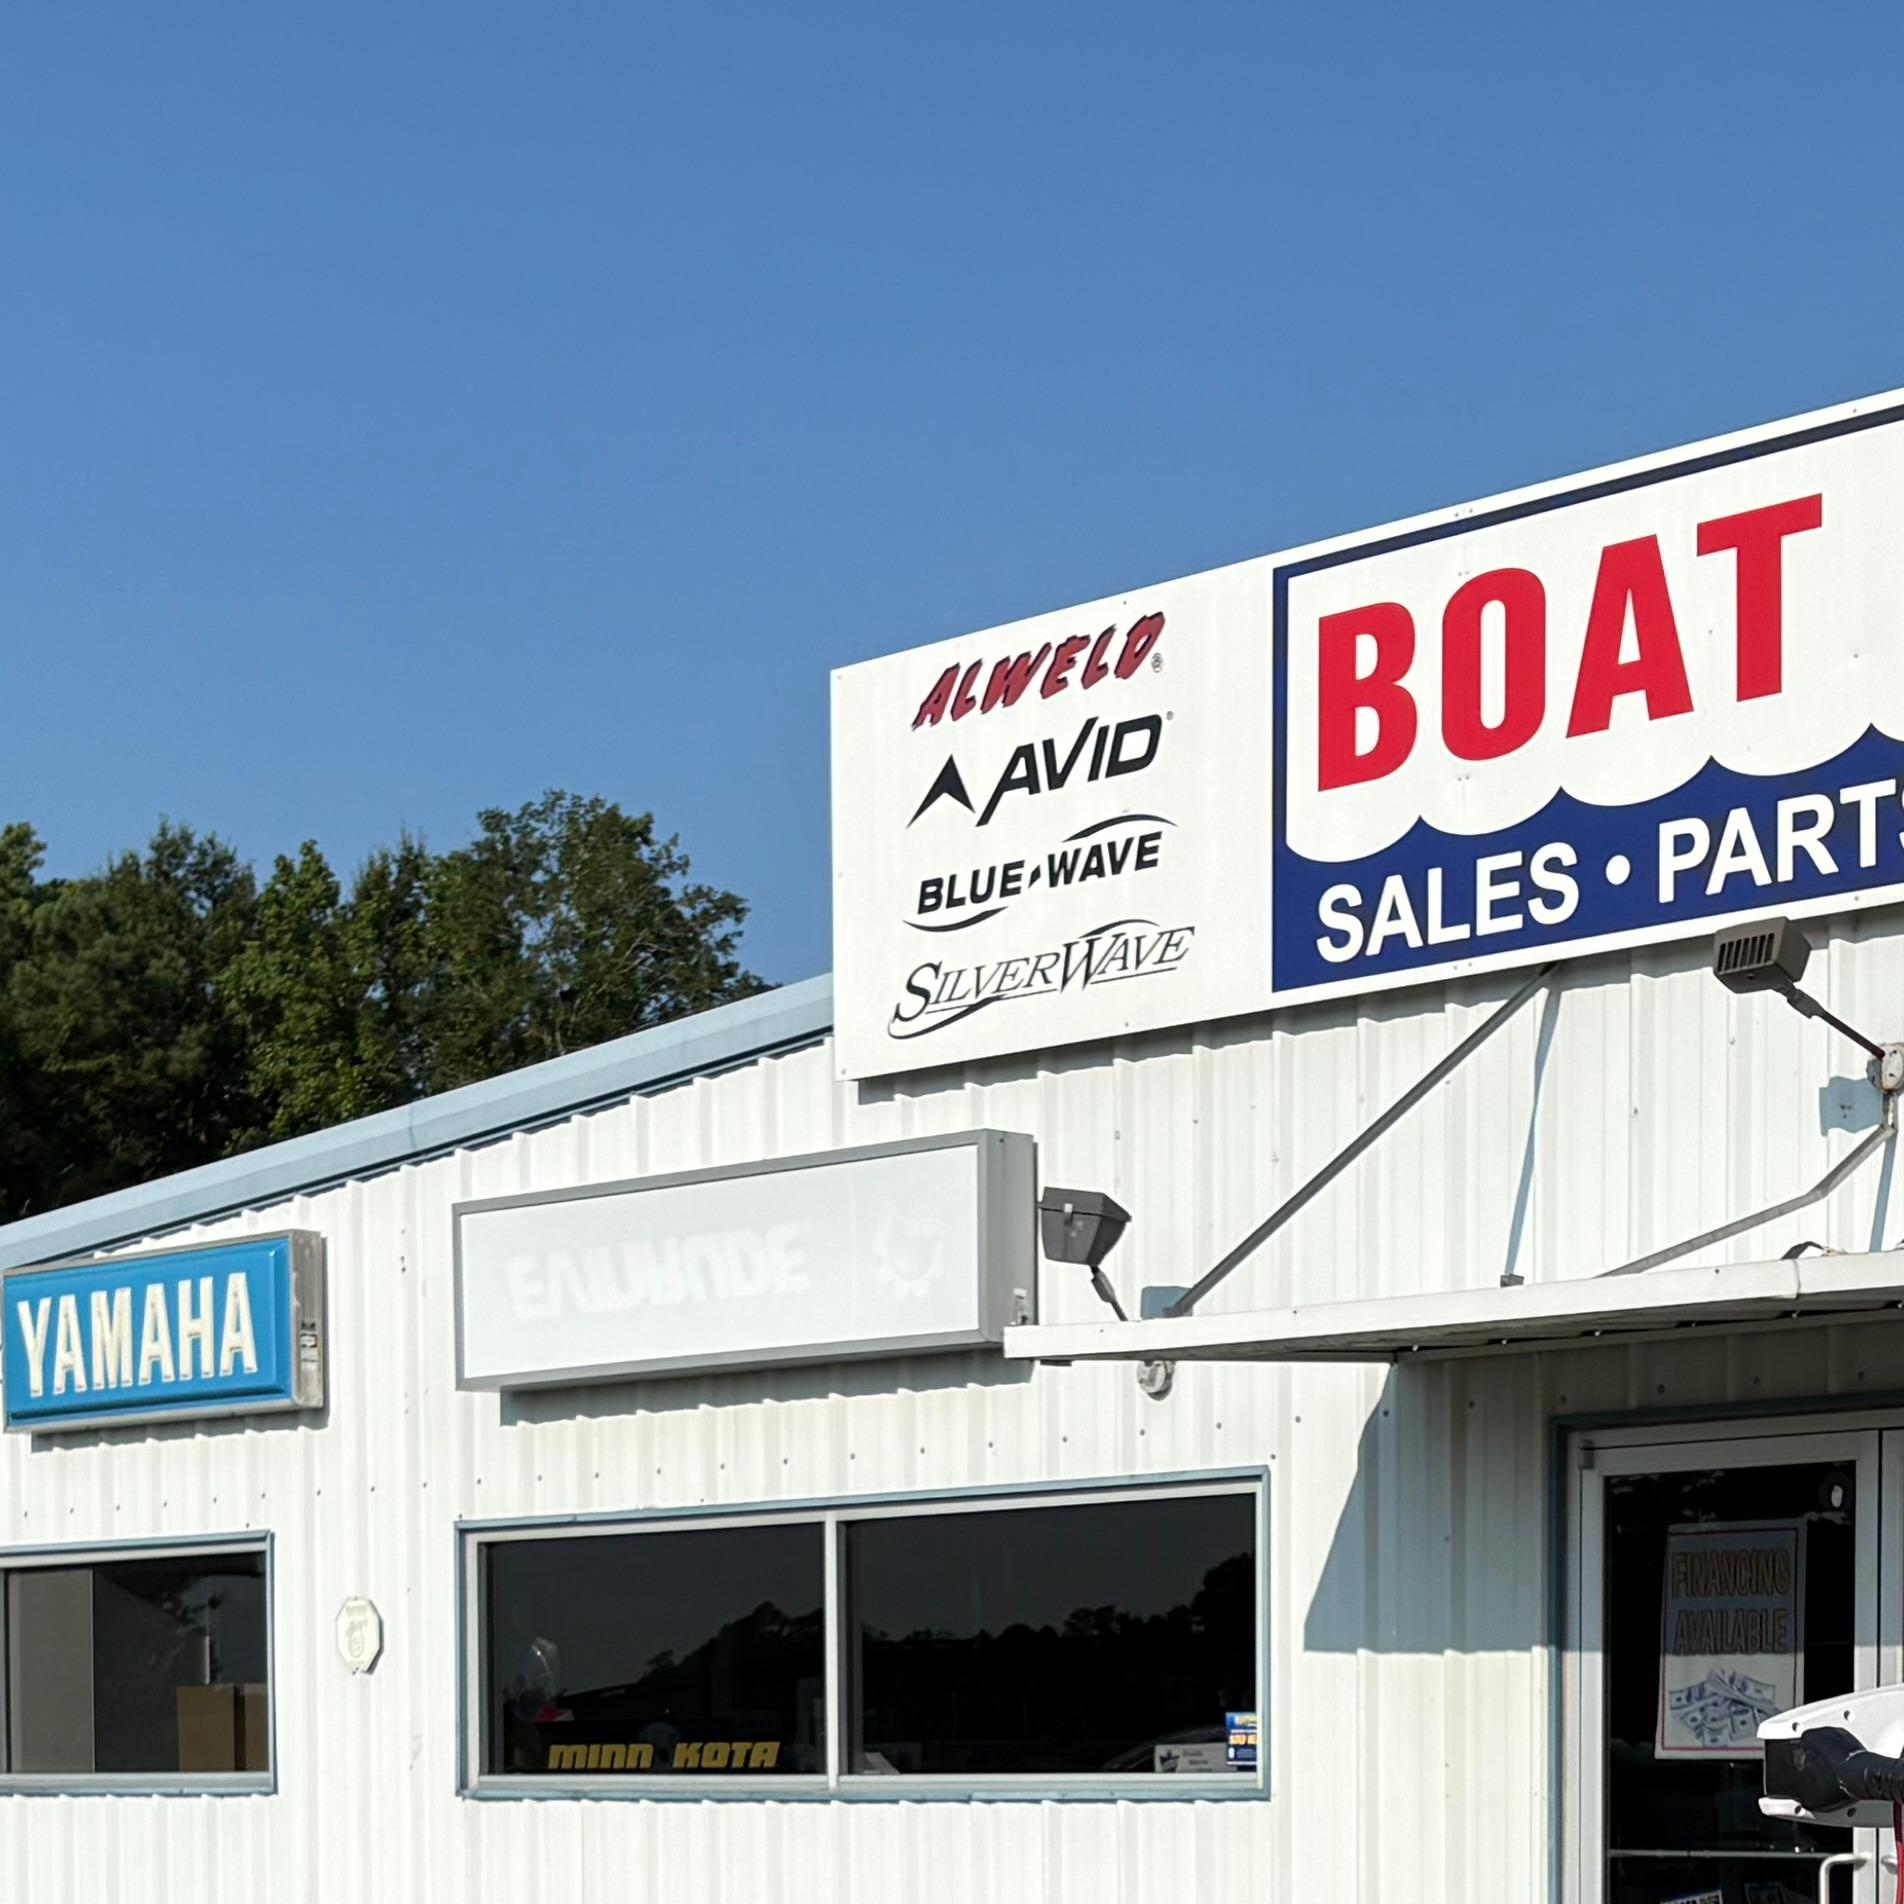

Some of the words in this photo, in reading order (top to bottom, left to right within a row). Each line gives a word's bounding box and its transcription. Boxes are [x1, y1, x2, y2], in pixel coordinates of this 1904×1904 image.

[909, 610, 1166, 732] ALWELD
[1316, 492, 1824, 793] BOAT
[974, 712, 1164, 828] AVID
[916, 858, 1027, 915] BLUE
[1047, 830, 1164, 890] WAVE
[1316, 841, 1581, 965] SALES
[17, 1270, 258, 1399] YAMAHA
[1671, 1547, 1792, 1599] FINANCING
[1673, 1607, 1789, 1657] AVAILABLE
[547, 1743, 655, 1771] MINN
[671, 1741, 782, 1769] KOTA
